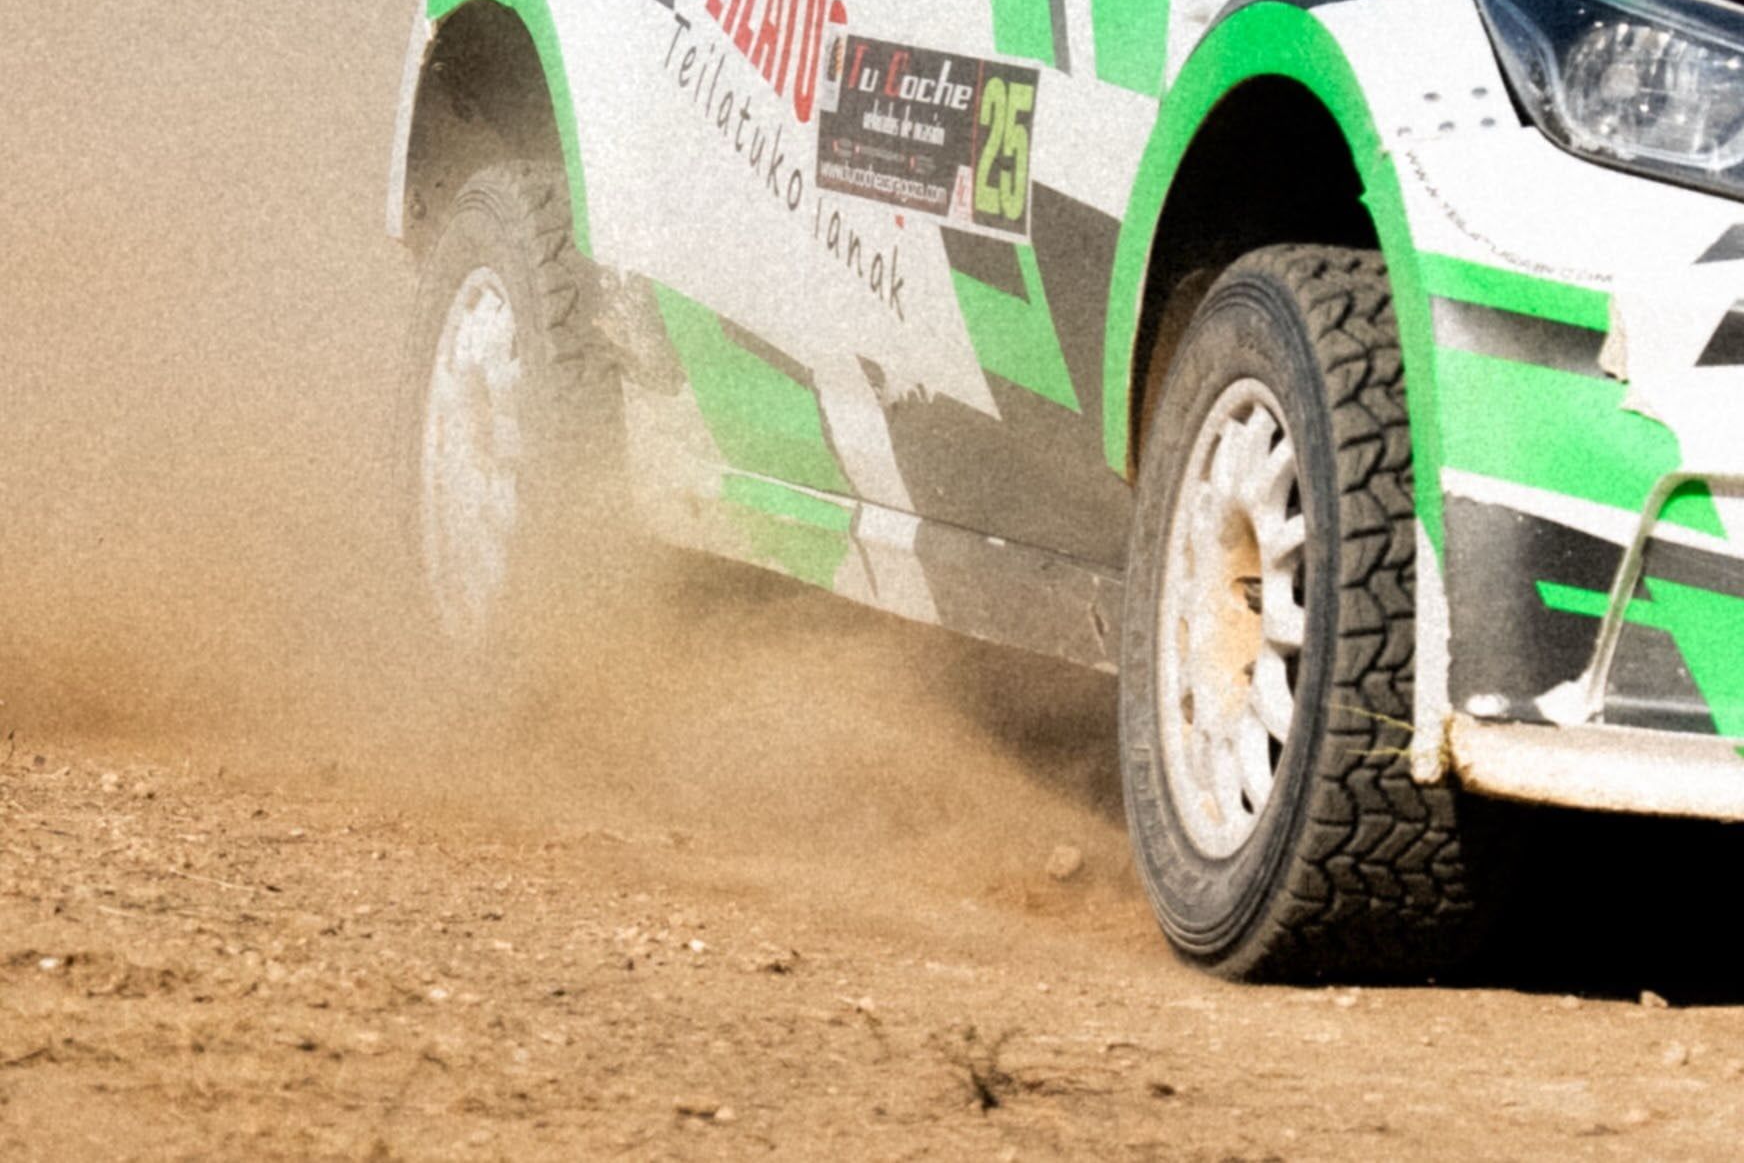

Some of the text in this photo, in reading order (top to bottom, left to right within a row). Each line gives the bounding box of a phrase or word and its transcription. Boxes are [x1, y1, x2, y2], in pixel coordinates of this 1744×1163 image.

[664, 13, 803, 212] Teilatuko
[848, 44, 879, 92] Tu
[884, 50, 973, 111] Coche
[972, 76, 1035, 221] 25
